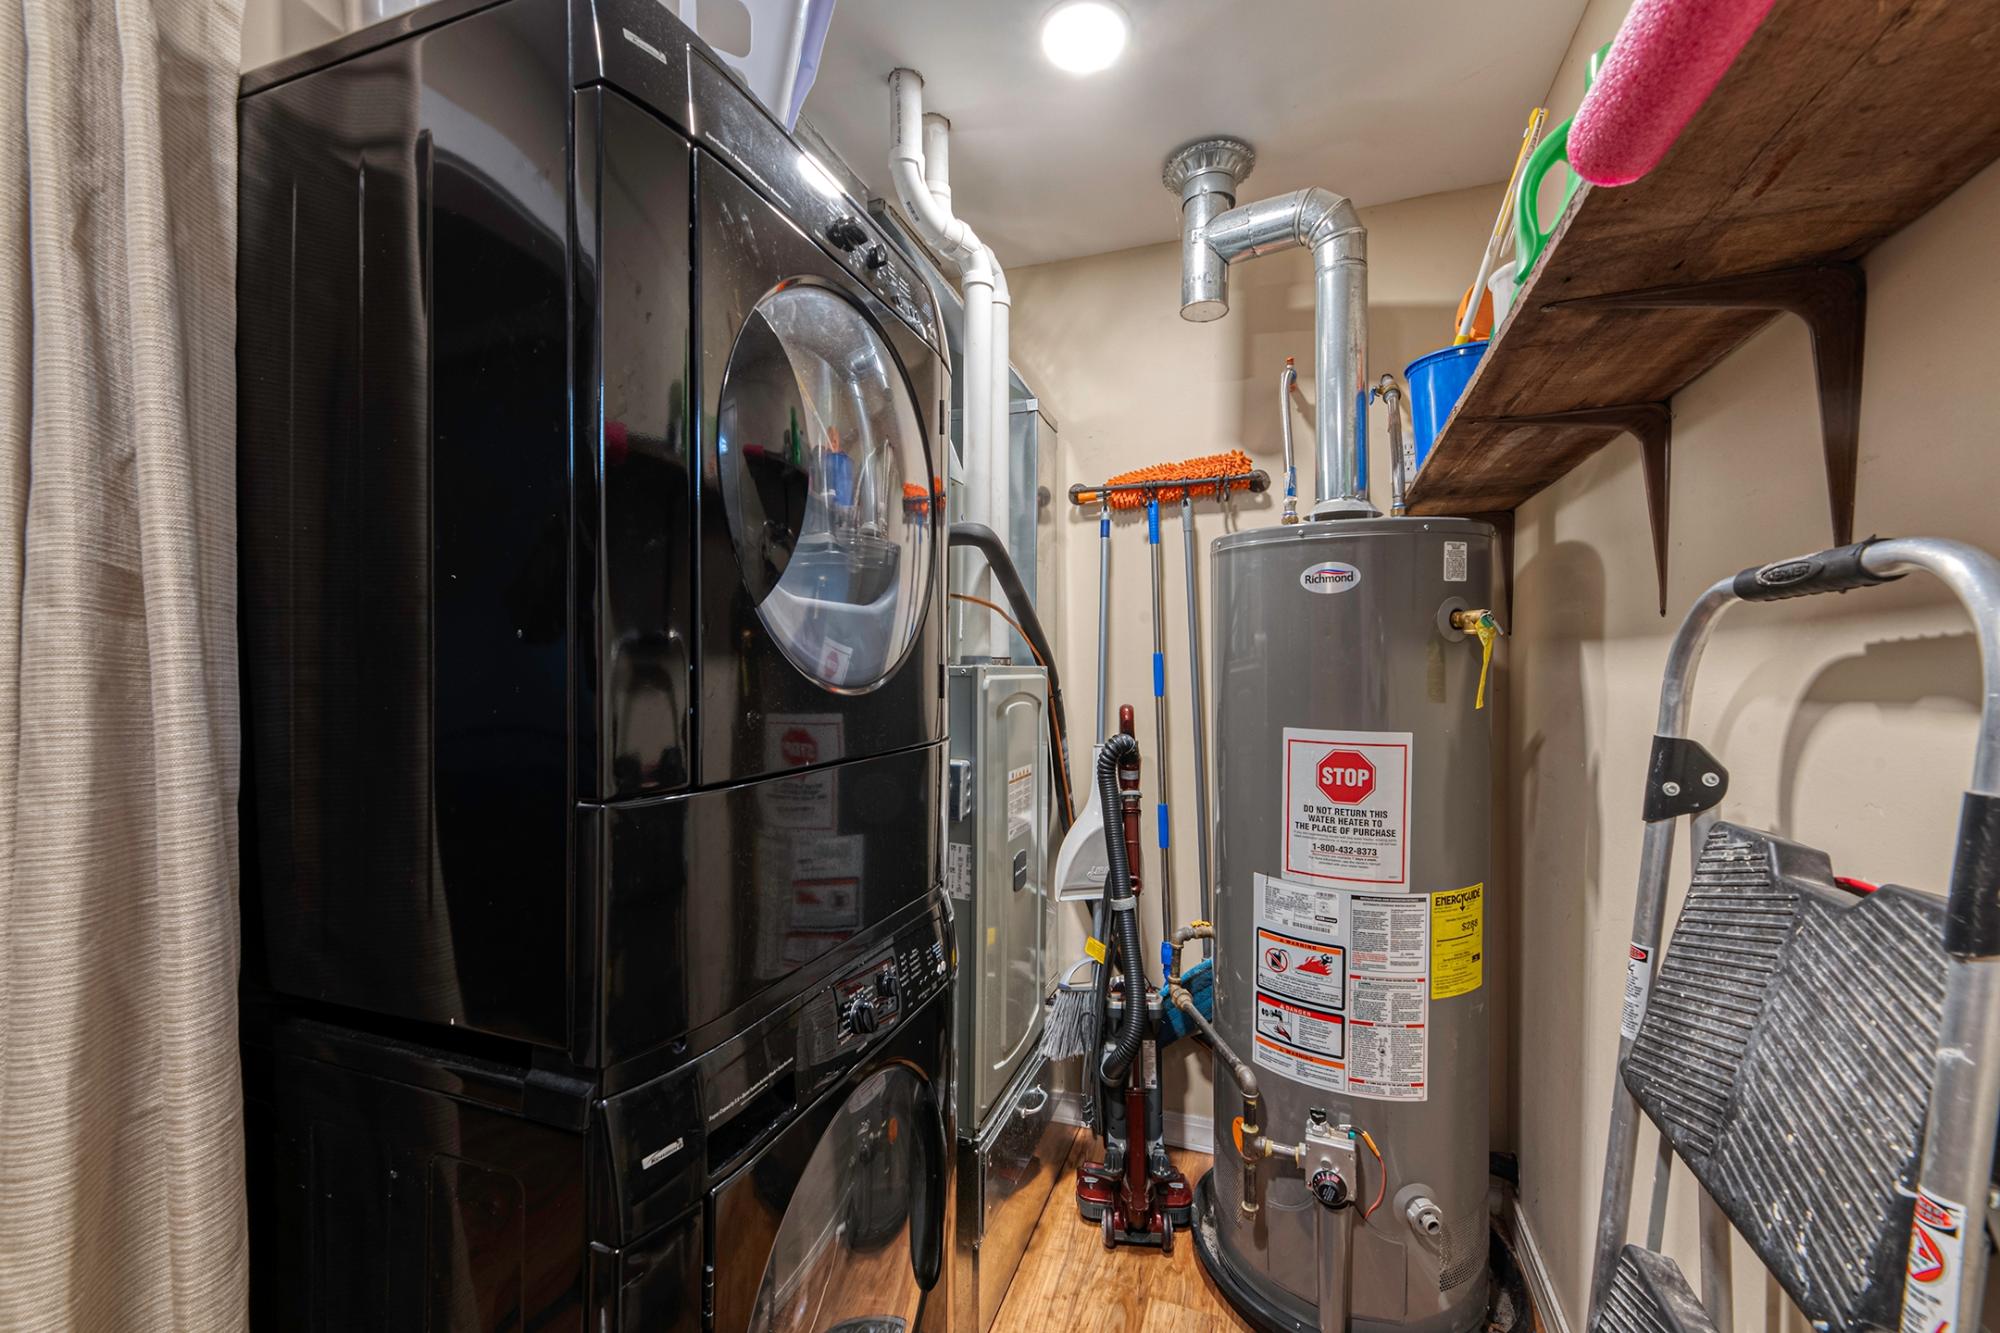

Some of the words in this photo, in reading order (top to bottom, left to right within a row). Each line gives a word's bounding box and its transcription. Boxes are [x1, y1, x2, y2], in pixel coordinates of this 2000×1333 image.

[1305, 571, 1354, 584] Richmond
[1322, 767, 1370, 786] STOP
[1303, 804, 1314, 813] DO
[1316, 806, 1332, 815] NOT
[1334, 808, 1367, 818] RETURN
[1369, 810, 1388, 819] THIS
[1308, 814, 1336, 824] WATER
[1337, 817, 1370, 827] HEATER
[1372, 819, 1383, 828] TO
[1295, 821, 1310, 831] THE
[1311, 823, 1337, 834] PLACE
[1339, 827, 1350, 835] OF
[1352, 828, 1397, 838] PURCHASE
[1312, 843, 1377, 856] 1-800-432-8373
[1286, 939, 1317, 951] WARNING
[1285, 1004, 1311, 1017] DANGER
